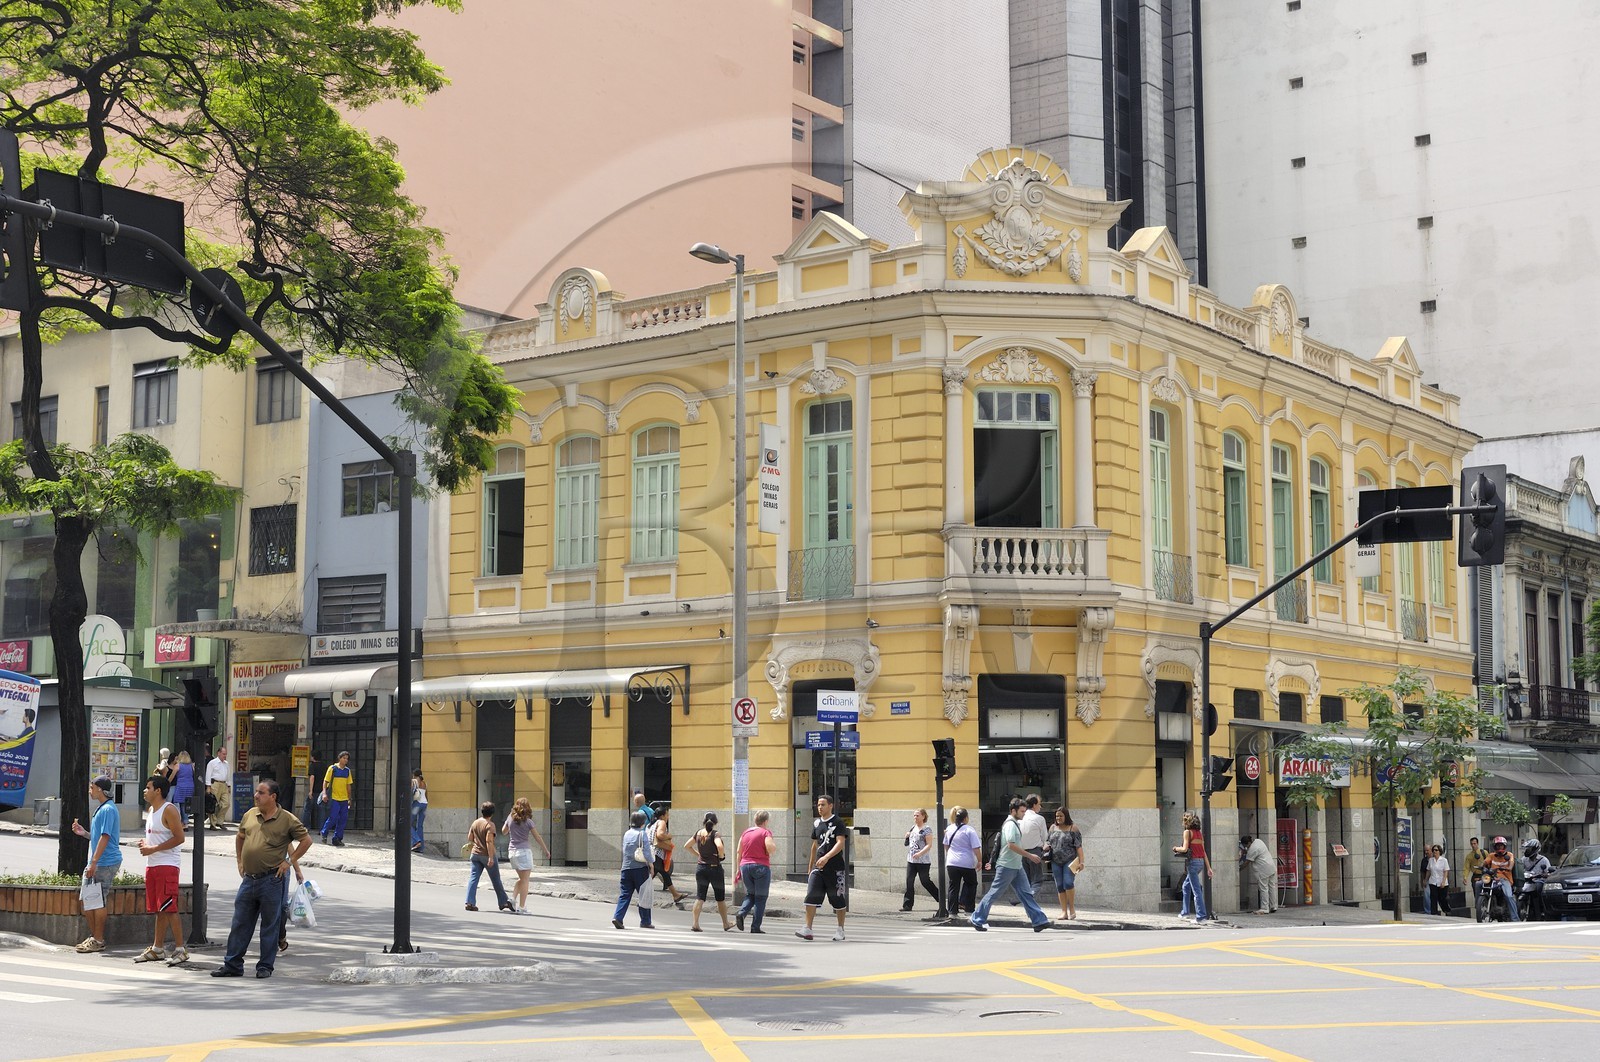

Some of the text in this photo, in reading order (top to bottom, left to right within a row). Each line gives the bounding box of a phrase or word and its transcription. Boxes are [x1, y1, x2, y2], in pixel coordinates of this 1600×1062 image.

[761, 466, 781, 476] CMG
[761, 482, 780, 492] COLÉGIO
[763, 492, 778, 501] MINAS
[763, 501, 778, 510] GERAIS
[158, 636, 187, 654] Coca-Cola
[330, 636, 399, 651] COLÉGIO MINAS GER
[233, 665, 253, 678] NOVA
[254, 665, 264, 678] BH
[18, 684, 40, 693] SOMA
[0, 688, 30, 703] NTEGRAL
[338, 700, 360, 708] CMG
[821, 695, 854, 707] citibank
[1247, 760, 1258, 770] 24
